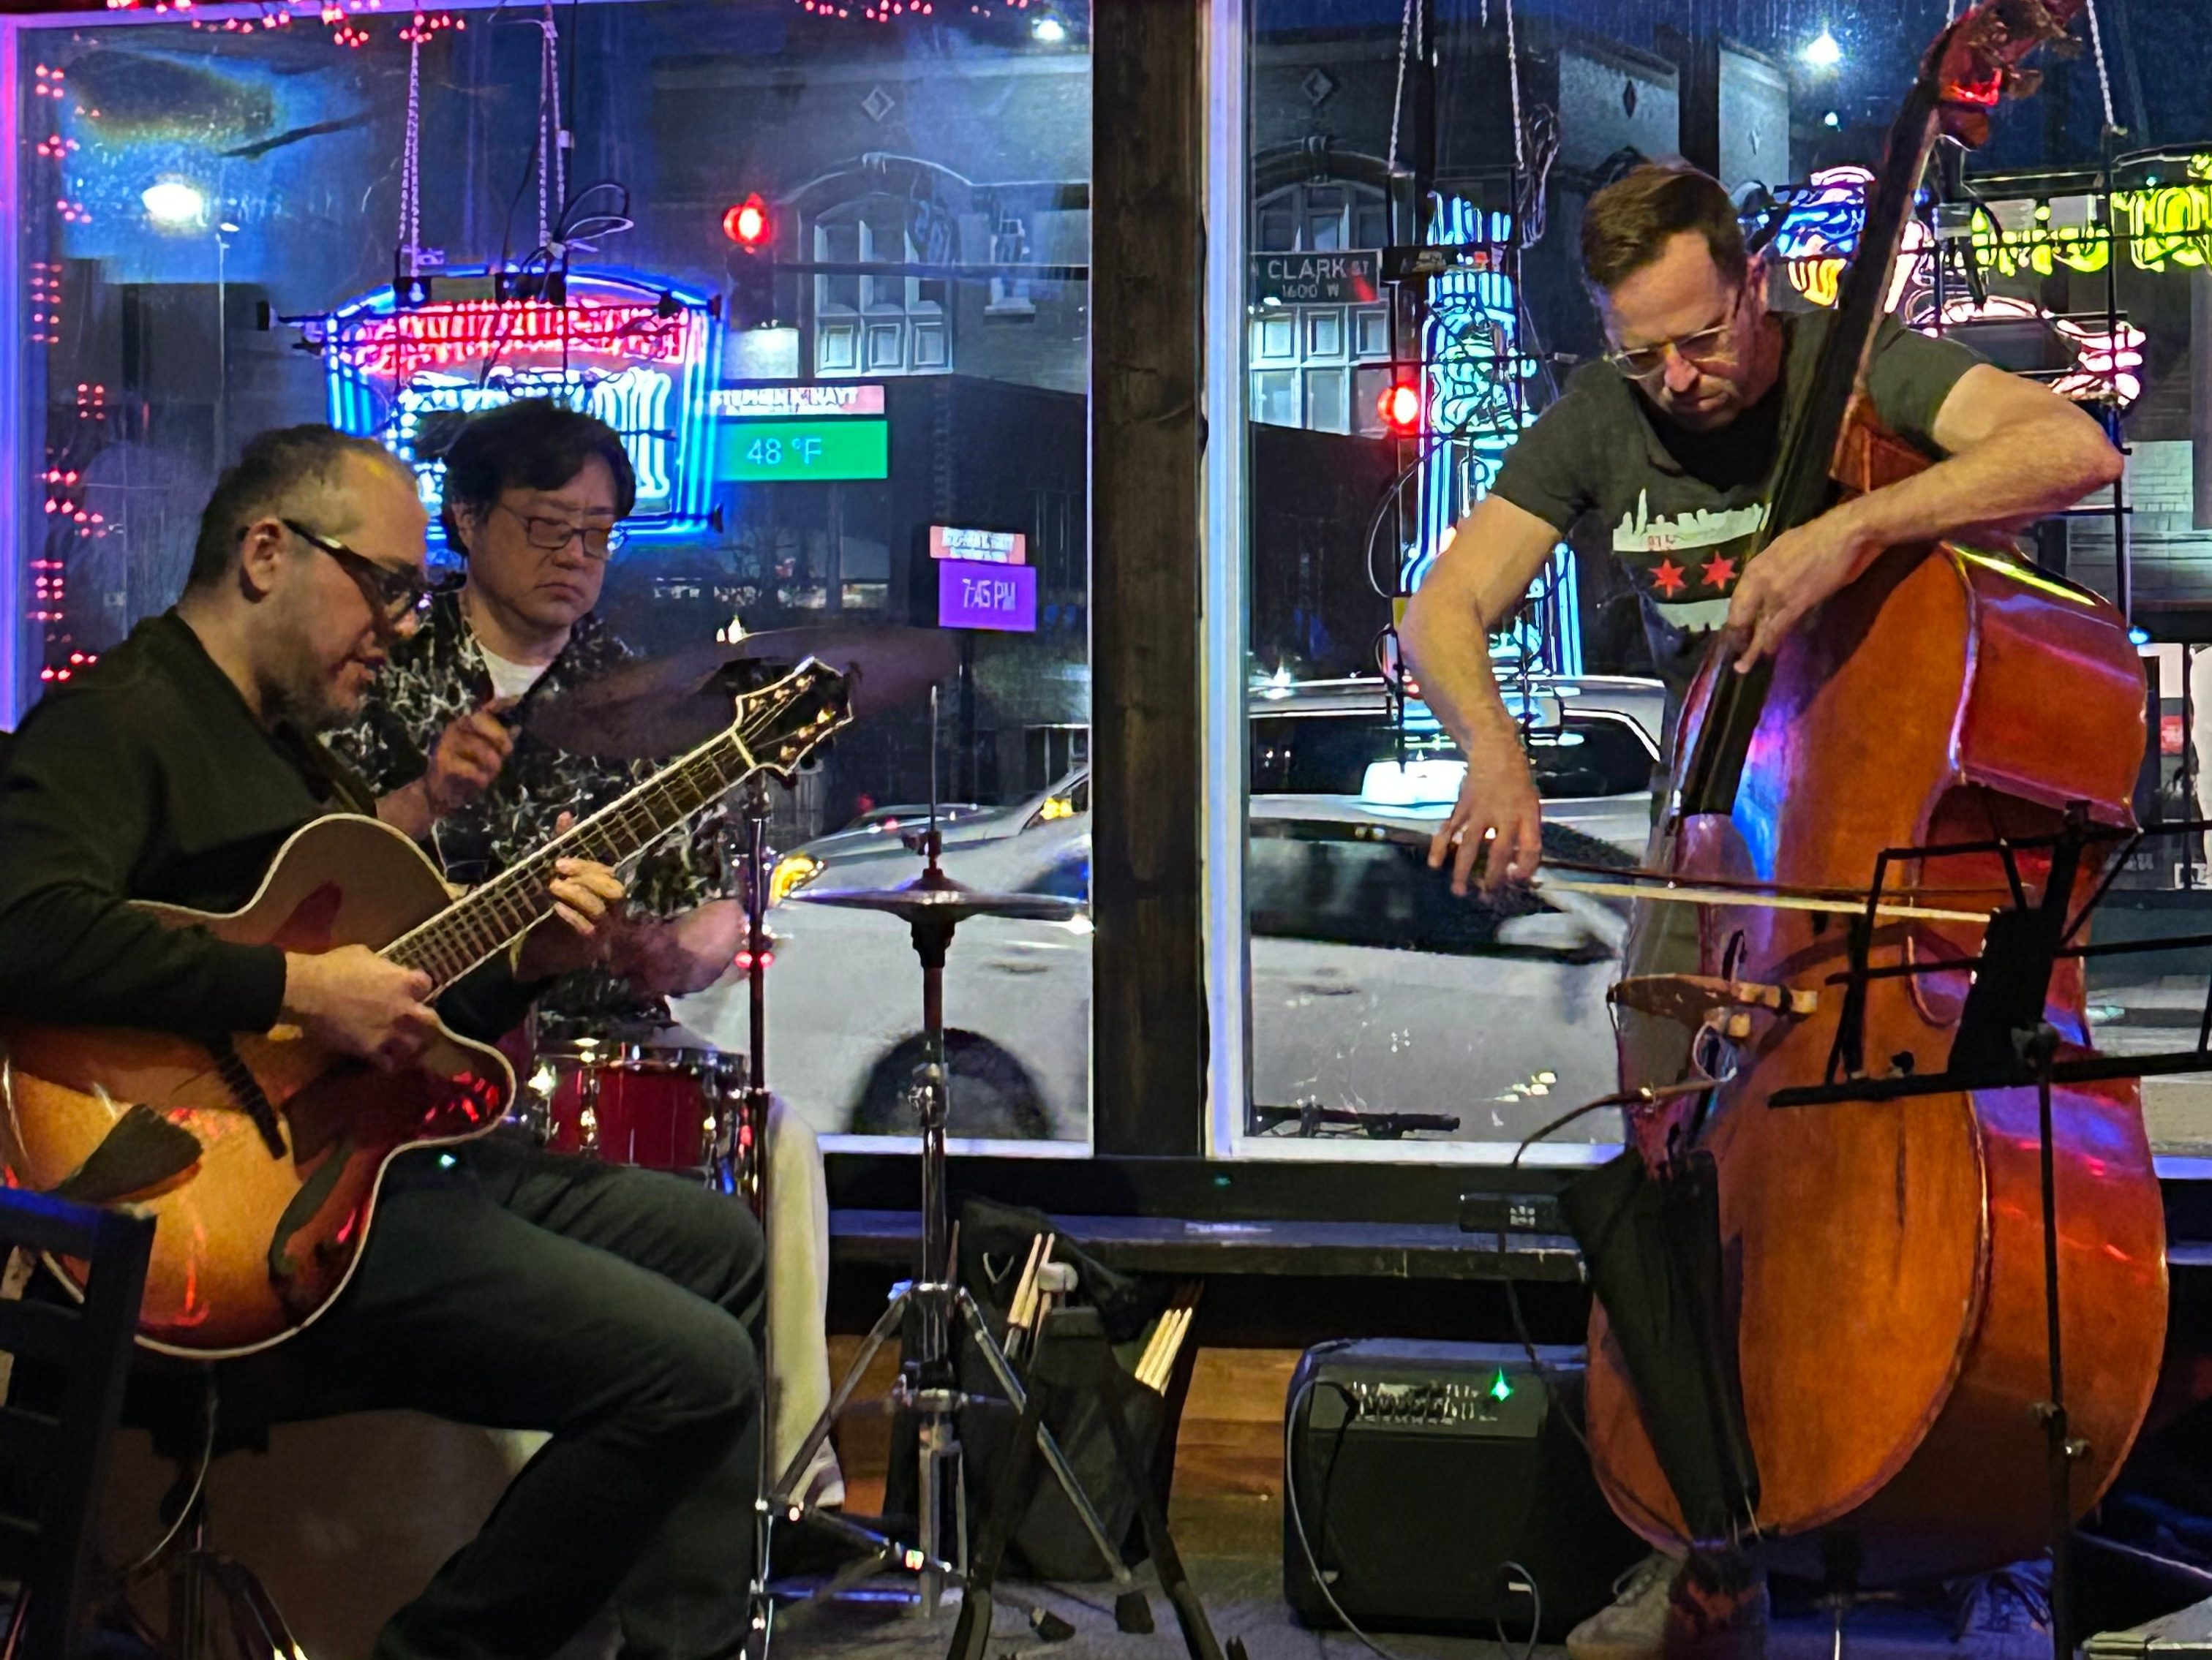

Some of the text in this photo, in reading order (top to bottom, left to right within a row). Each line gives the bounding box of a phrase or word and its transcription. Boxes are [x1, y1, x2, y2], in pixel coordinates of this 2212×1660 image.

[1268, 258, 1347, 282] CLARK
[1282, 284, 1339, 298] 1600 W
[746, 437, 822, 465] 48 °F
